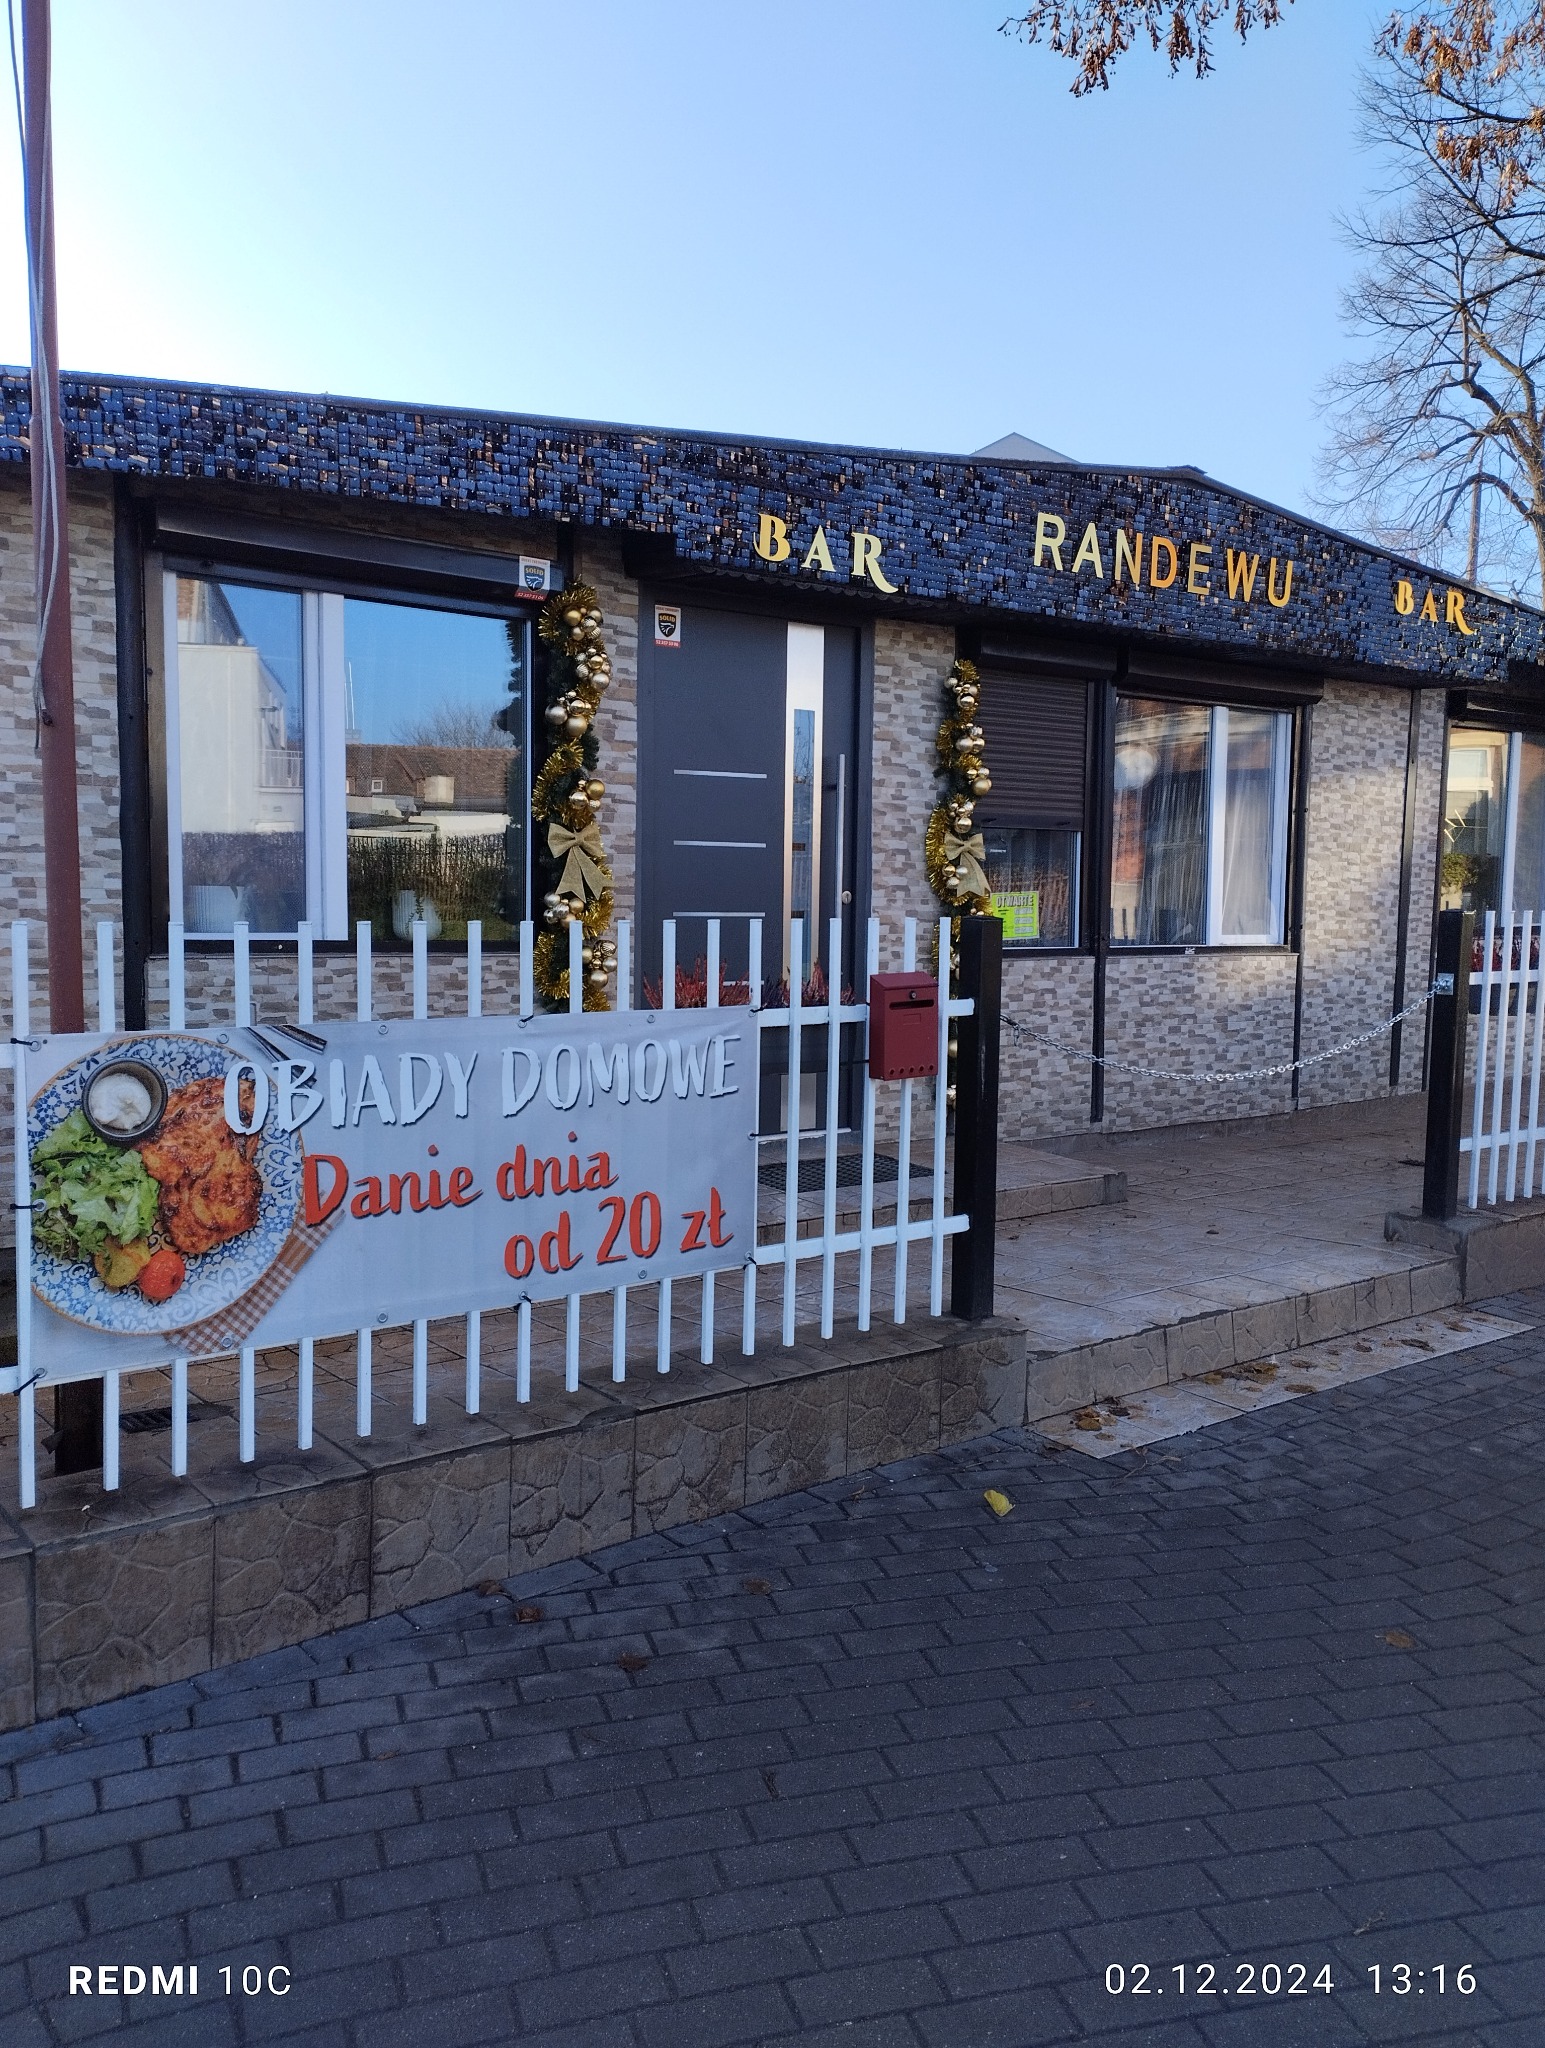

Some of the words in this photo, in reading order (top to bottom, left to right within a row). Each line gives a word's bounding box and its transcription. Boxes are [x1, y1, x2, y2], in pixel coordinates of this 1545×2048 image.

[754, 512, 899, 594] BAR
[1032, 511, 1296, 610] RANDEWU
[1394, 580, 1476, 637] BAR
[996, 895, 1034, 908] OTWARTE
[223, 1051, 479, 1135] OBIADY
[501, 1034, 741, 1118] DOMOWE
[303, 1145, 482, 1227] Danie
[495, 1131, 619, 1201] dnia
[504, 1211, 582, 1279] od
[596, 1191, 661, 1265] 20
[680, 1186, 734, 1252] zł
